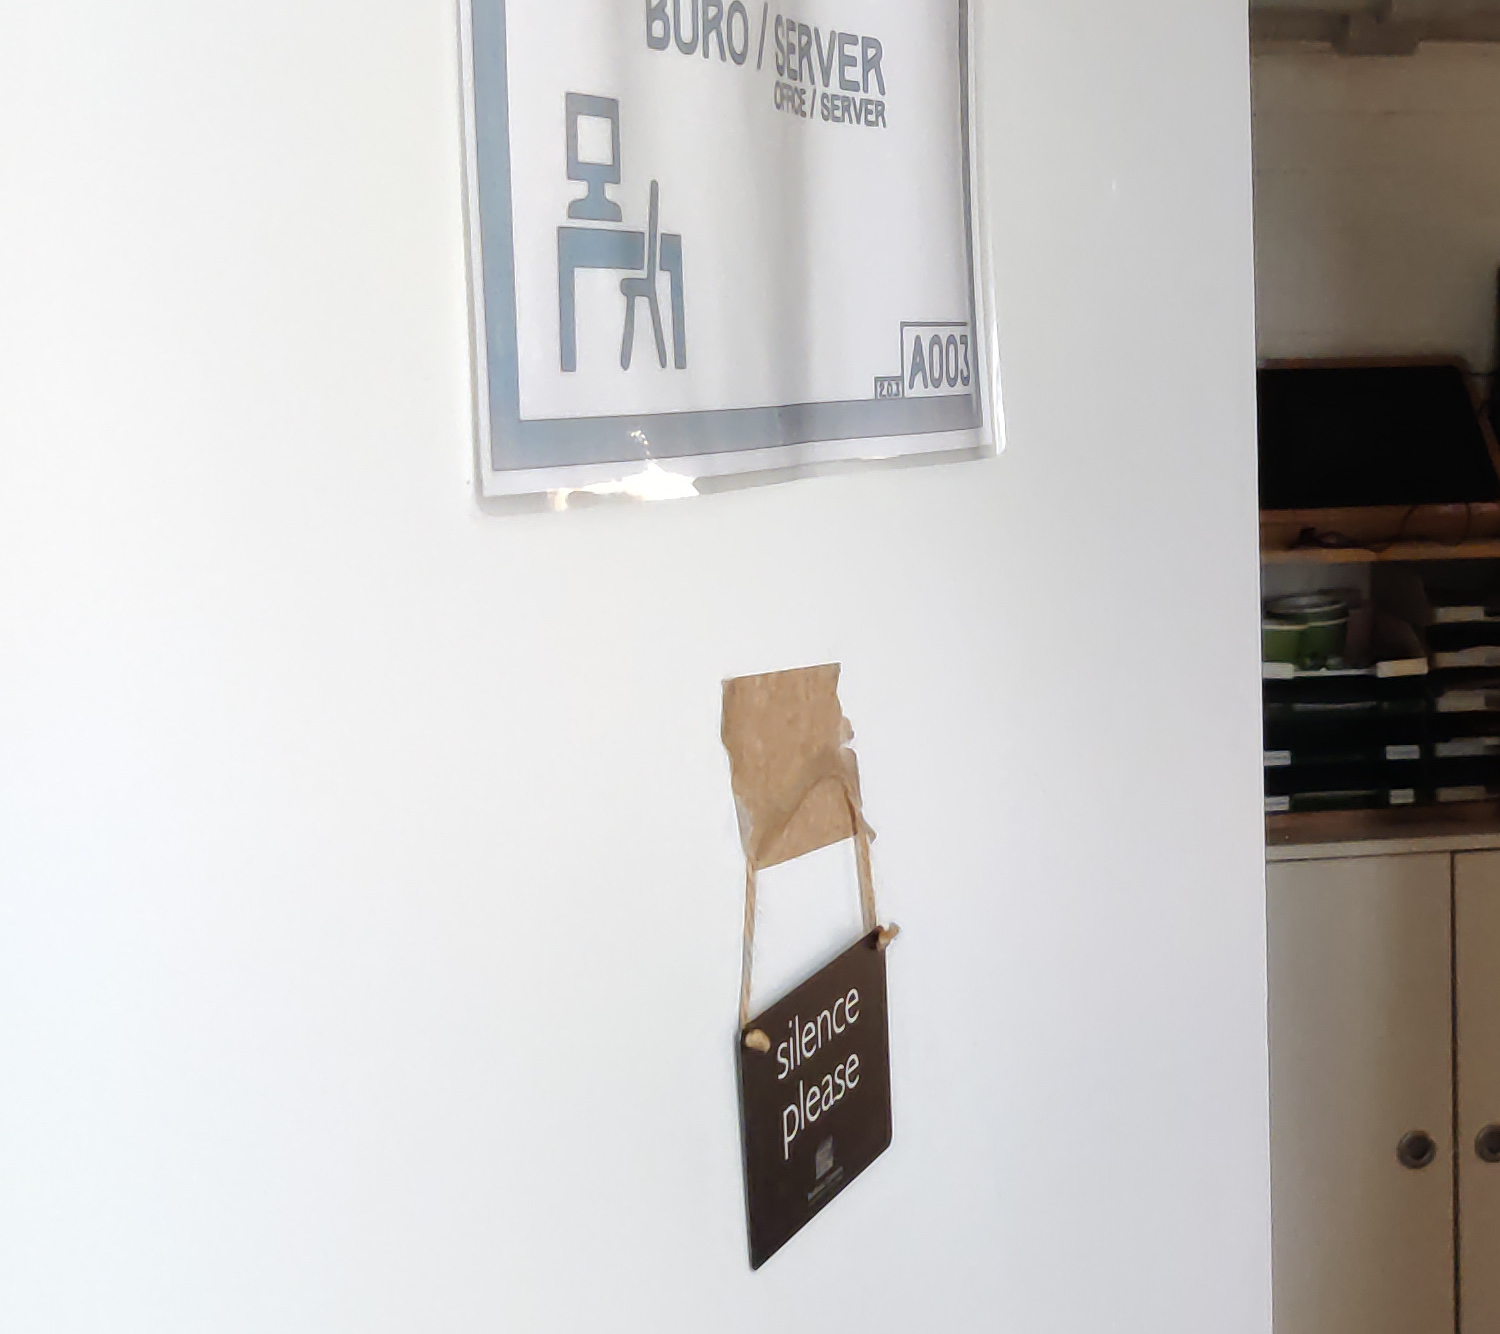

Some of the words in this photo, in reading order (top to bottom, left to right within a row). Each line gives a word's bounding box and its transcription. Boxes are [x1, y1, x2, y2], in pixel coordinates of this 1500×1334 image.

[756, 2, 769, 71] /
[774, 14, 886, 96] SERVER
[810, 87, 817, 120] /
[820, 93, 887, 129] SERVER
[908, 333, 971, 390] A003
[776, 987, 860, 1080] silence
[782, 1053, 860, 1161] please
